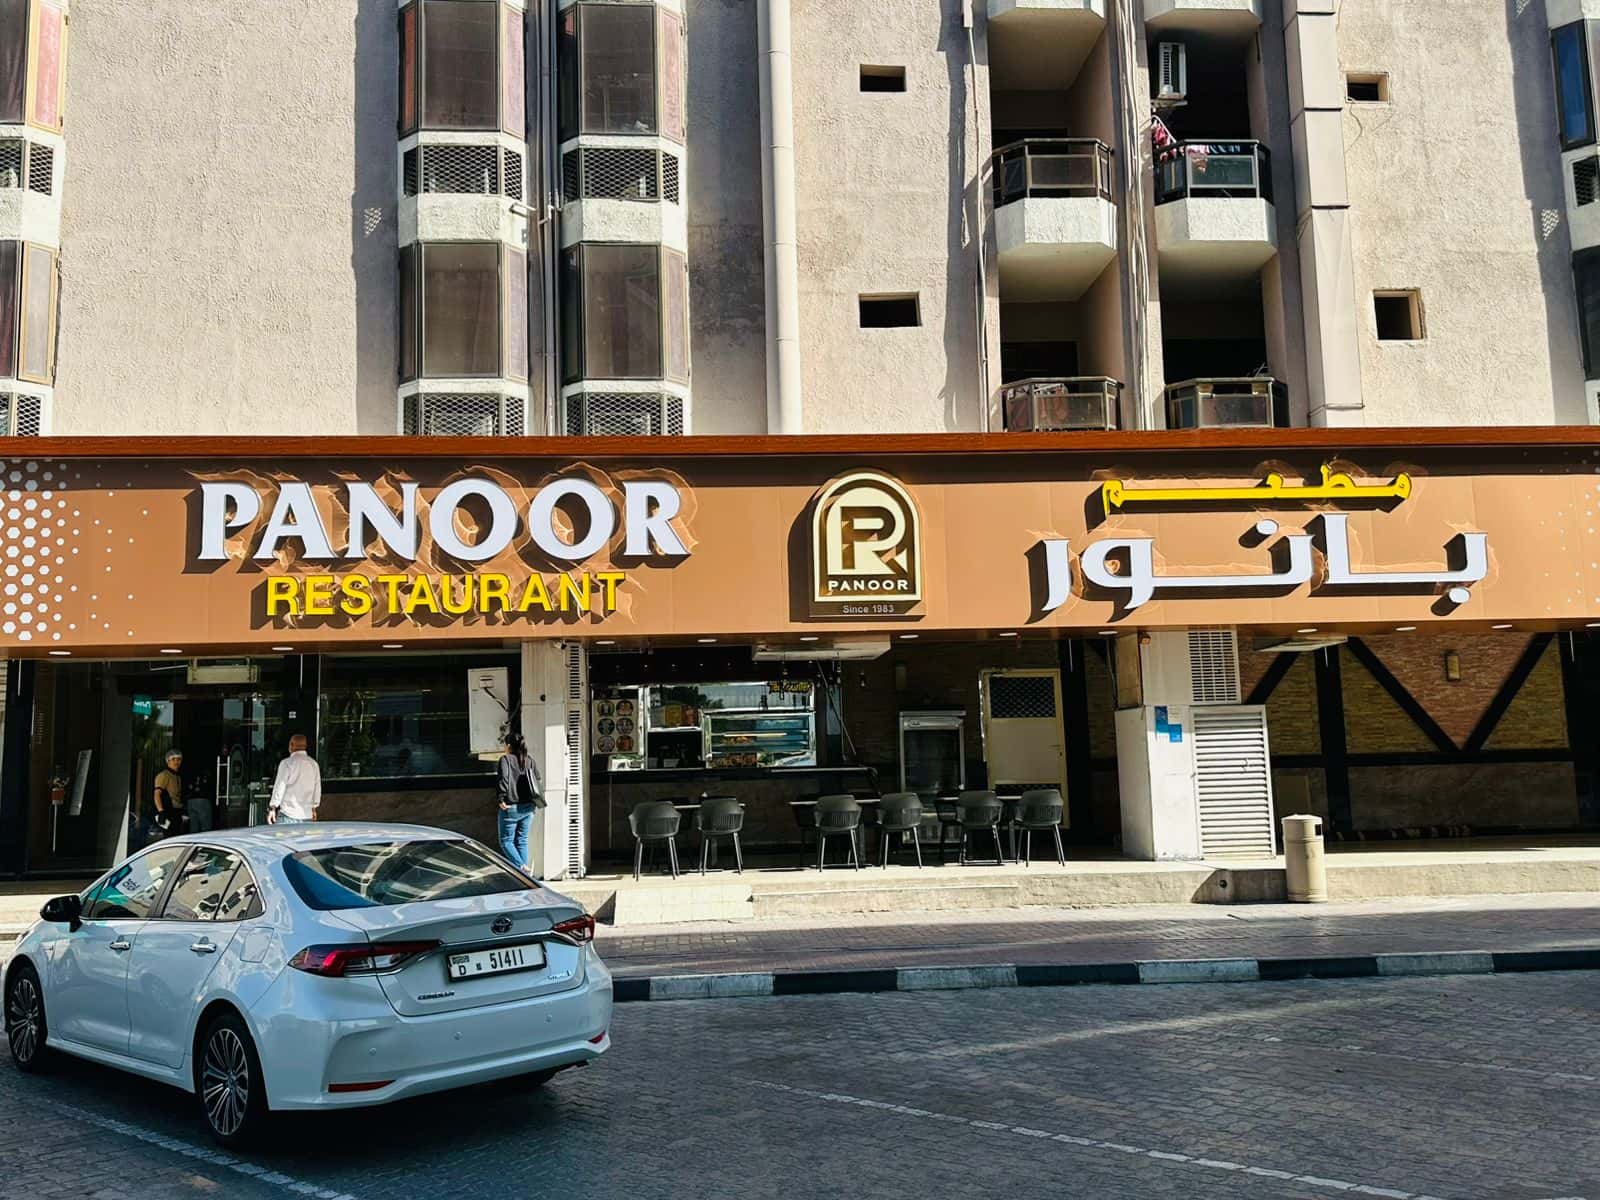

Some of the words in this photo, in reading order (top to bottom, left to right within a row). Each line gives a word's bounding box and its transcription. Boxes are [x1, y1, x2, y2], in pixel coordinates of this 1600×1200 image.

[1102, 465, 1411, 513] مطعم
[198, 478, 688, 561] PANOOR
[1042, 512, 1489, 611] بانور
[266, 573, 624, 616] RESTAURANT
[828, 579, 909, 591] PANOOR
[842, 604, 869, 614] Since
[872, 604, 895, 614] 1983
[489, 948, 525, 970] 51411
